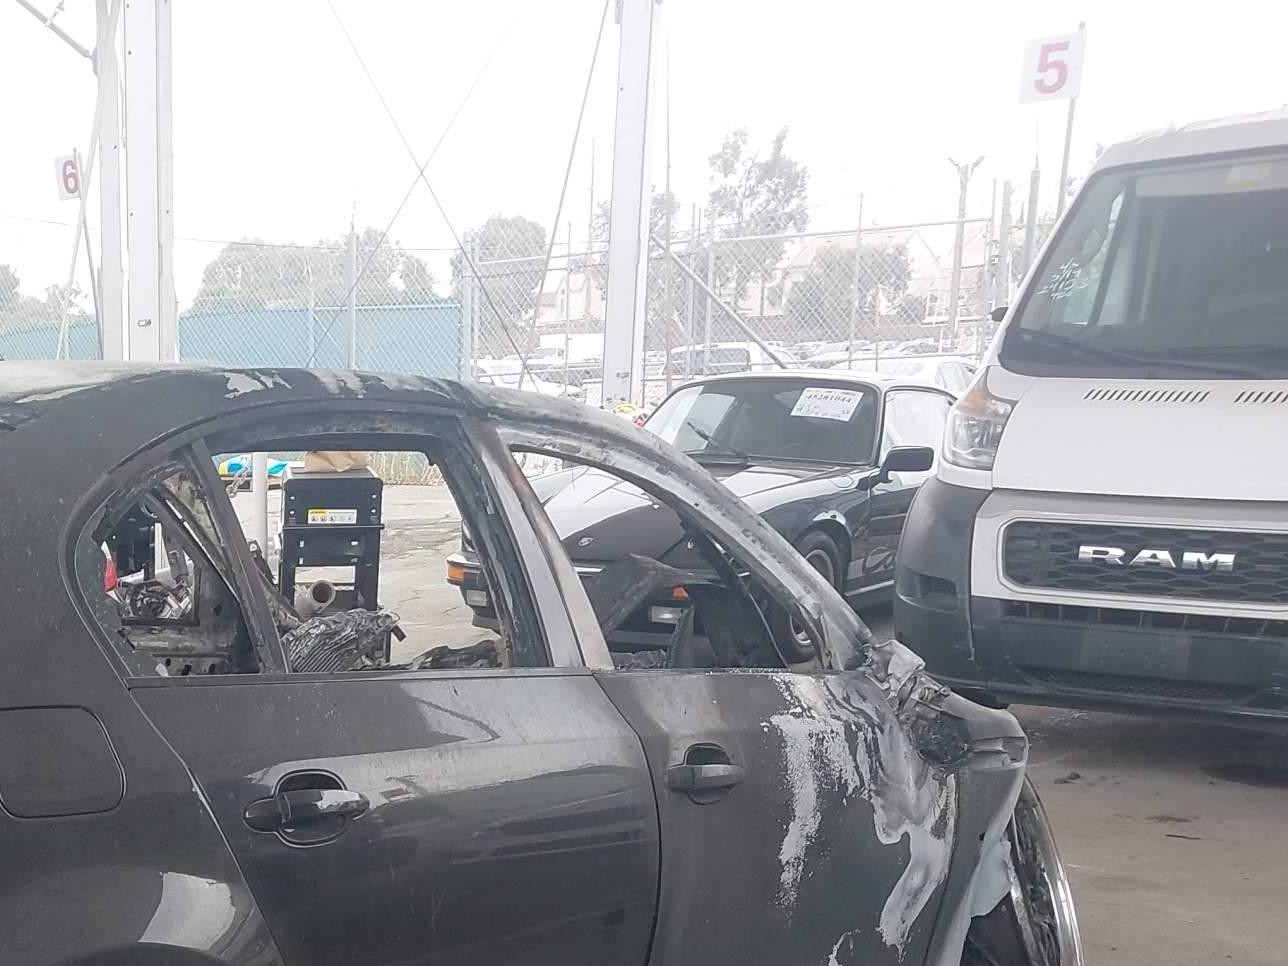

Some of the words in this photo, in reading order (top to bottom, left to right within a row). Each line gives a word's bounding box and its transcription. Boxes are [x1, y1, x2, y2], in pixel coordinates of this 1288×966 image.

[1034, 41, 1070, 94] 5
[62, 160, 79, 193] 6
[1078, 545, 1236, 571] RAM
